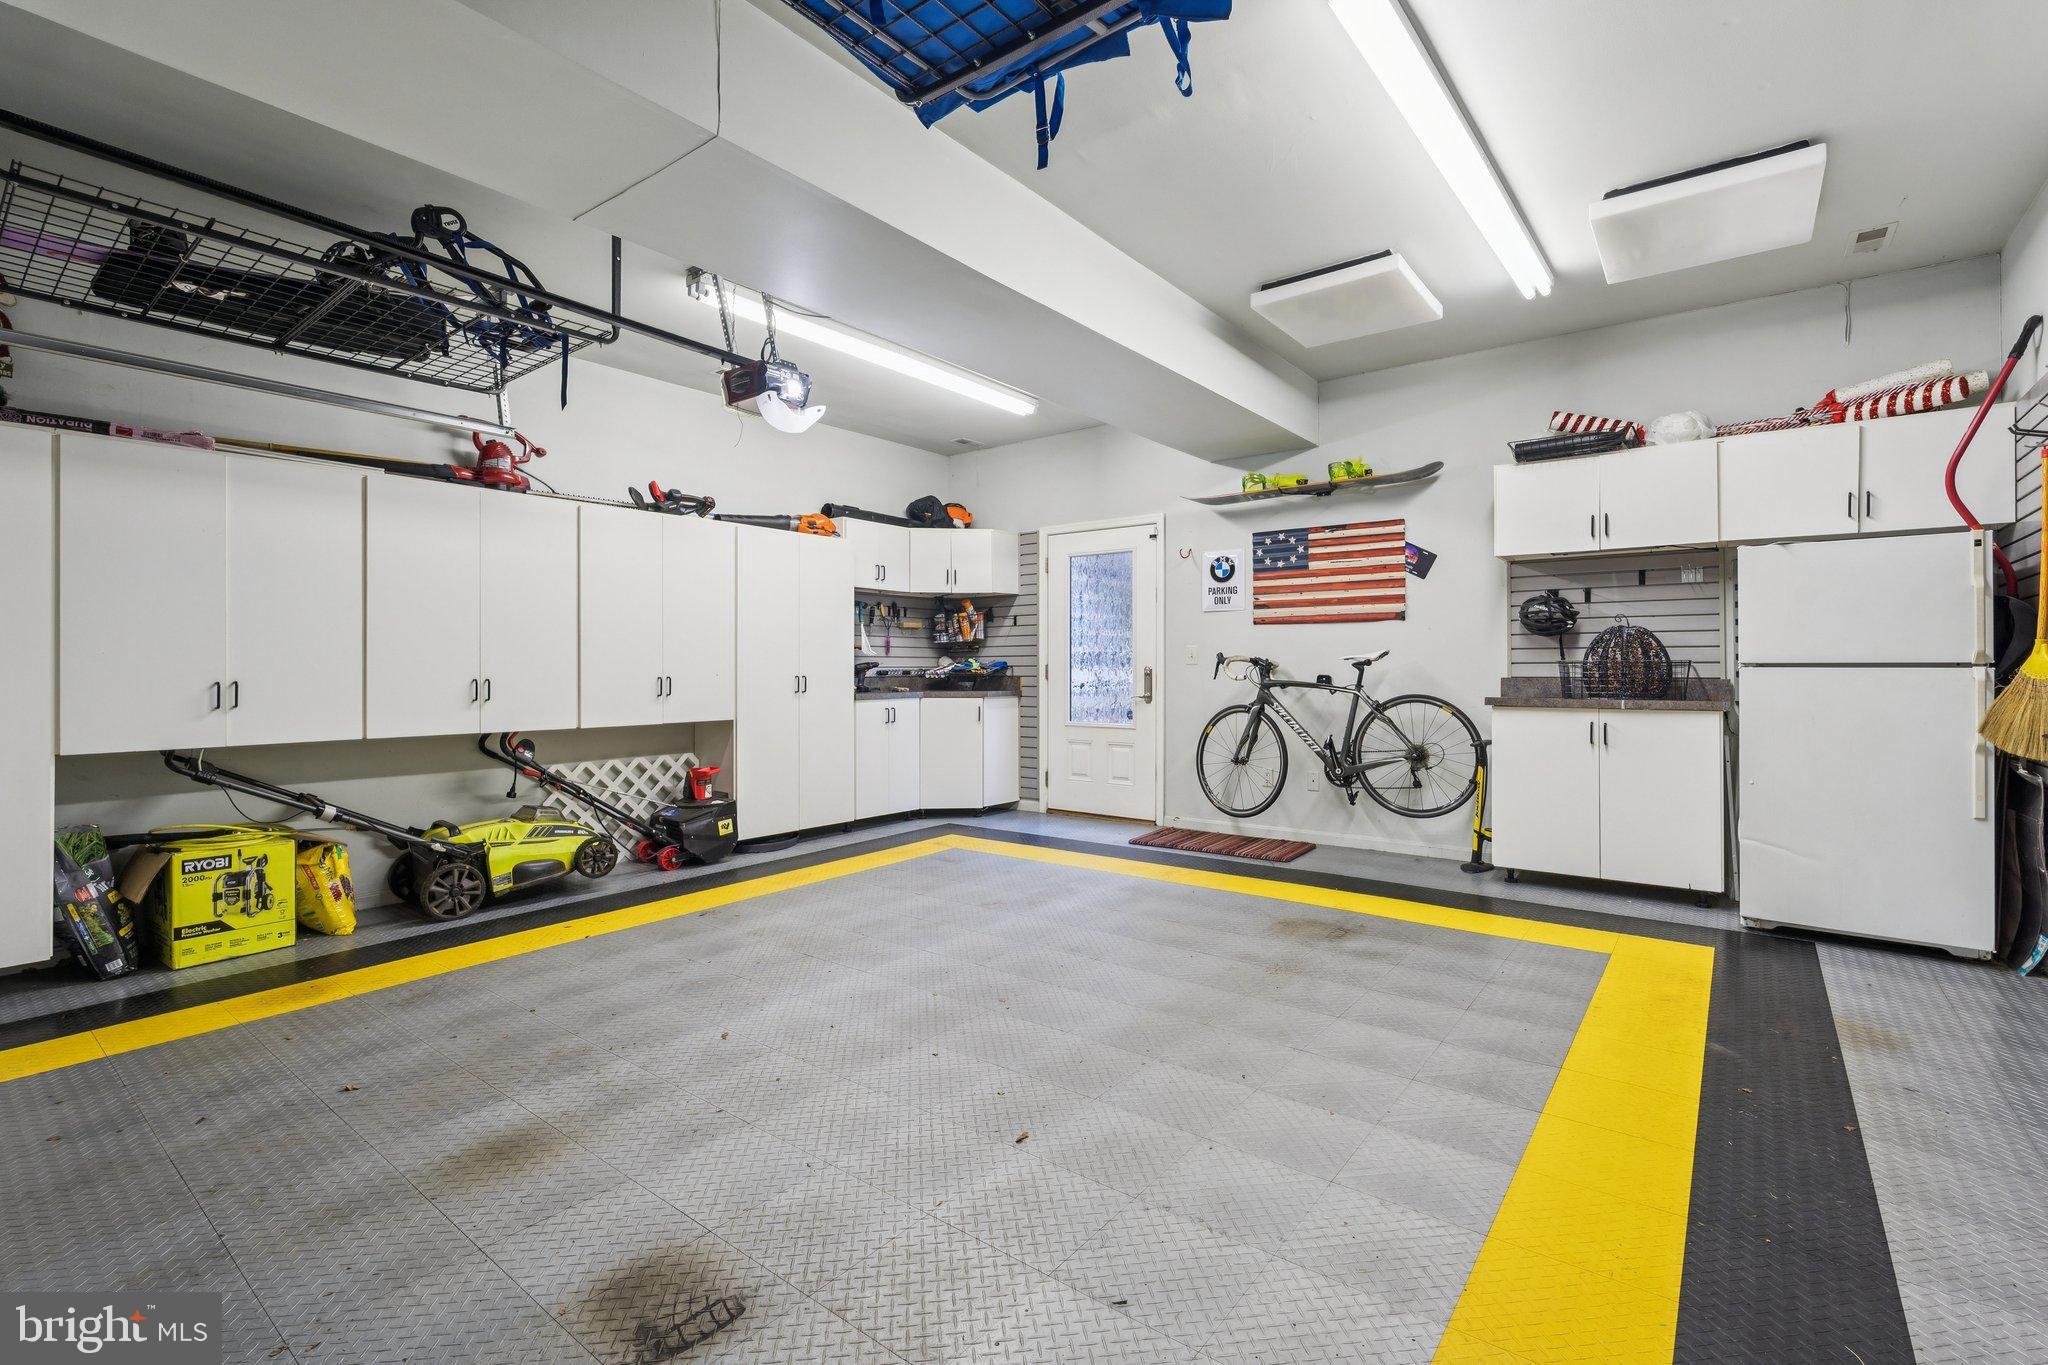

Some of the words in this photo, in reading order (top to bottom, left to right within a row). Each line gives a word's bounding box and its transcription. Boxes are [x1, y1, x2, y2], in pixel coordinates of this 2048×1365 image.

[26, 415, 93, 430] DURATION
[1211, 556, 1235, 567] BMW
[1207, 586, 1238, 596] PARKING
[1213, 596, 1232, 606] ONLY
[1271, 702, 1322, 752] SPECIALIZED
[183, 857, 229, 873] RYOBI
[181, 925, 208, 936] Electric
